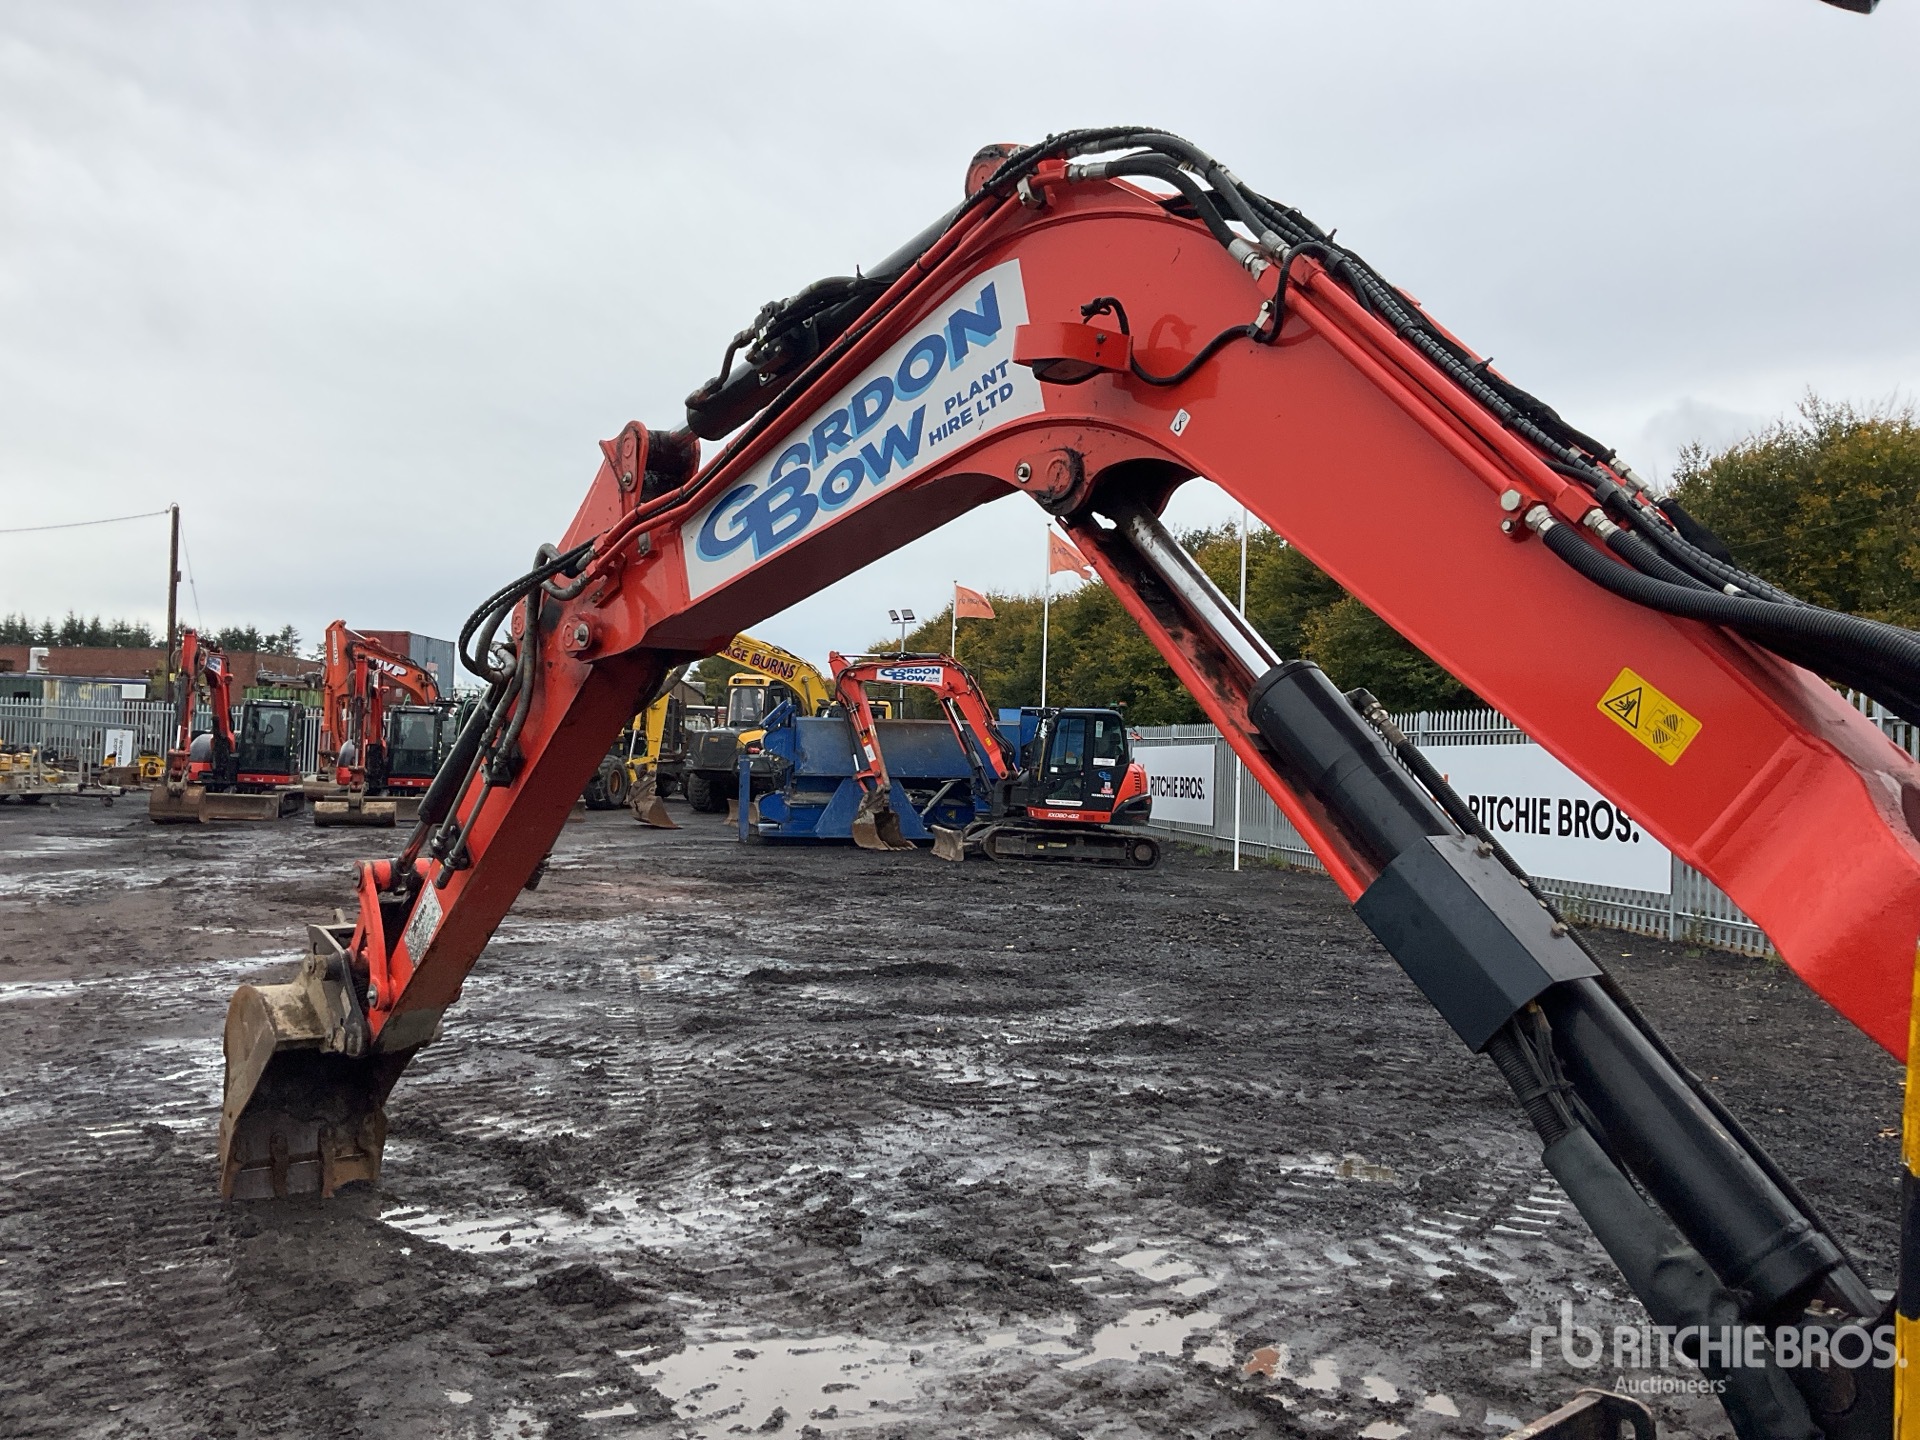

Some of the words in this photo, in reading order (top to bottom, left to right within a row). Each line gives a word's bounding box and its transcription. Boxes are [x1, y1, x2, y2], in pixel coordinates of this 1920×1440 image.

[944, 359, 1009, 415] PLANT
[696, 281, 1002, 562] GORDON
[929, 407, 973, 447] HIRE
[976, 382, 1014, 417] LTD
[753, 404, 926, 561] BOW
[750, 653, 796, 679] BURNS
[892, 671, 926, 682] BOW
[1150, 775, 1178, 798] RITCHIE
[1558, 798, 1640, 844] BROS.
